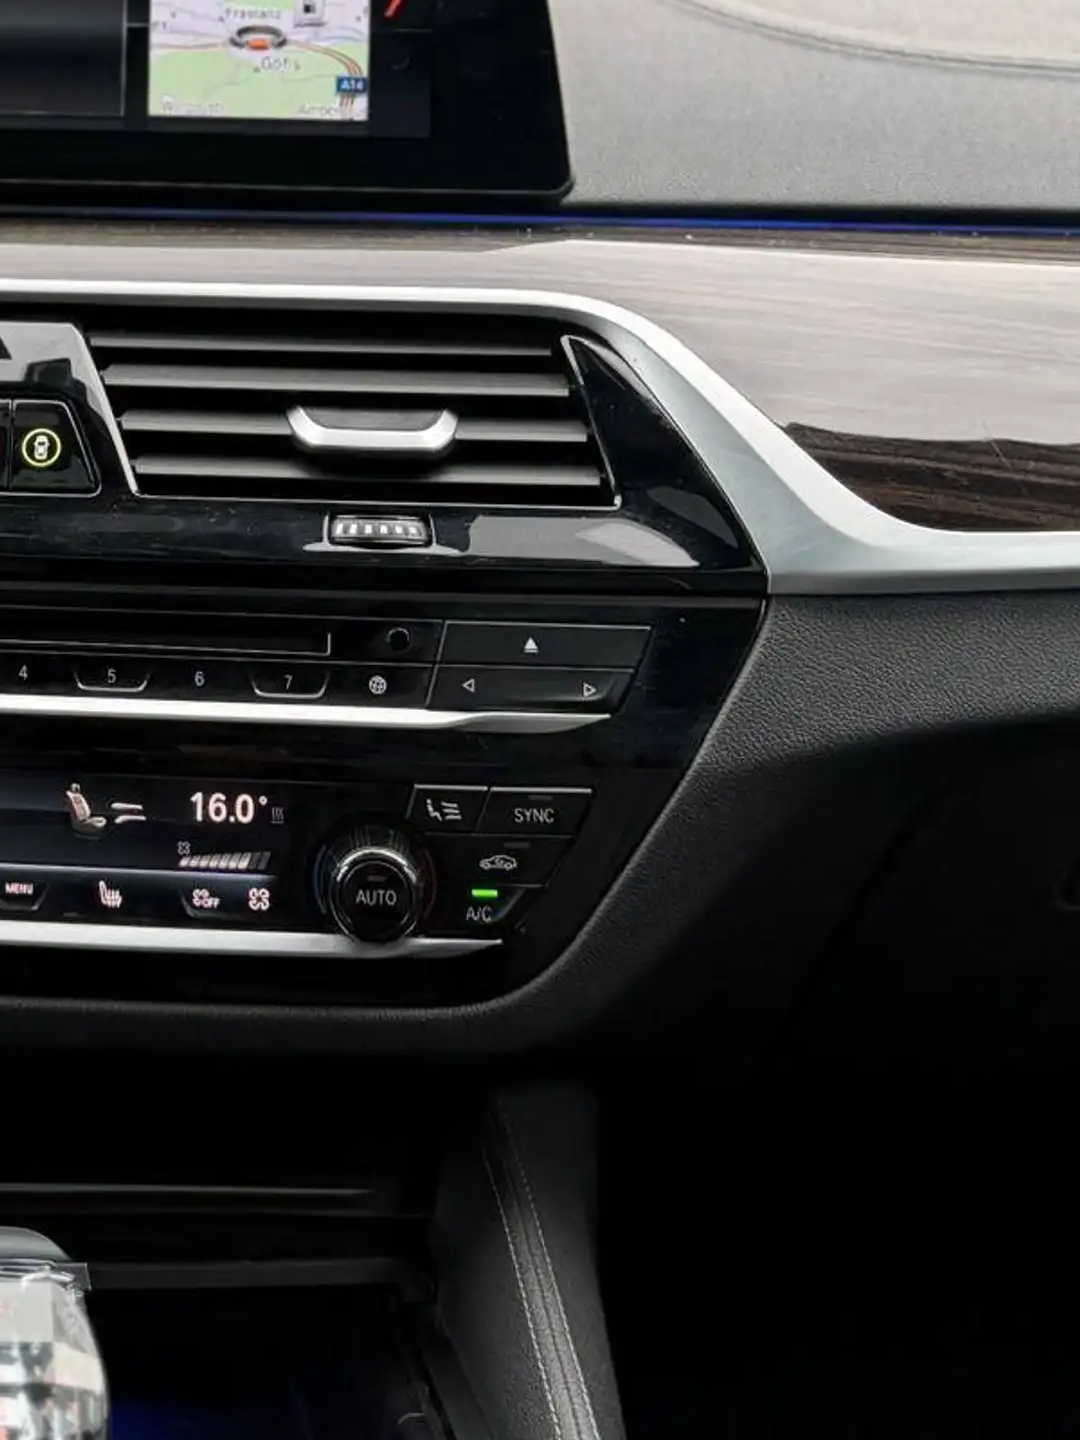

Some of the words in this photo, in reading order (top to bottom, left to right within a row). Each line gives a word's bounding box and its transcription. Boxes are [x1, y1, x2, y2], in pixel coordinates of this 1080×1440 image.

[18, 665, 29, 681] 4
[107, 669, 117, 684] 5
[194, 671, 205, 687] 6
[284, 675, 293, 690] 7
[190, 792, 268, 824] 16.0°
[514, 808, 555, 824] SYNC
[5, 882, 34, 895] MENU
[356, 889, 397, 906] AUTO
[466, 906, 493, 922] A/C
